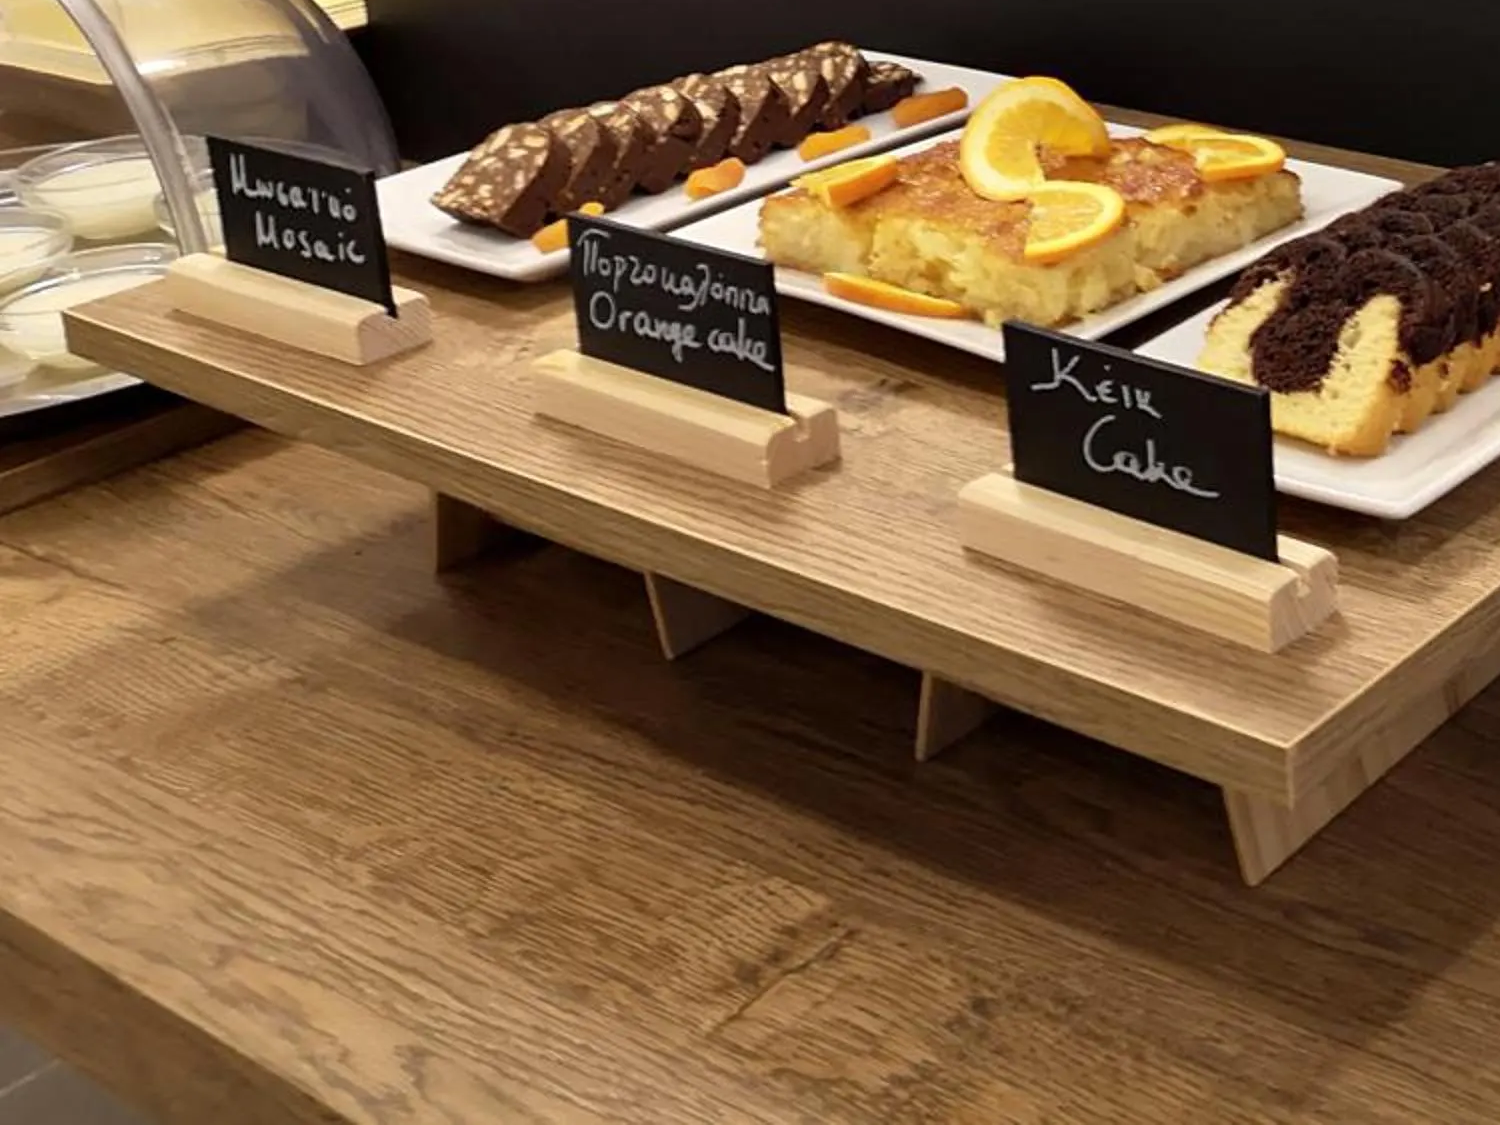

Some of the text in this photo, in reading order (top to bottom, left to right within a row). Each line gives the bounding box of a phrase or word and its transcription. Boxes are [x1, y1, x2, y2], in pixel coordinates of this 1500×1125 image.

[256, 210, 366, 264] Mosaic
[589, 291, 775, 372] Orange cake
[1083, 414, 1220, 498] Cake
